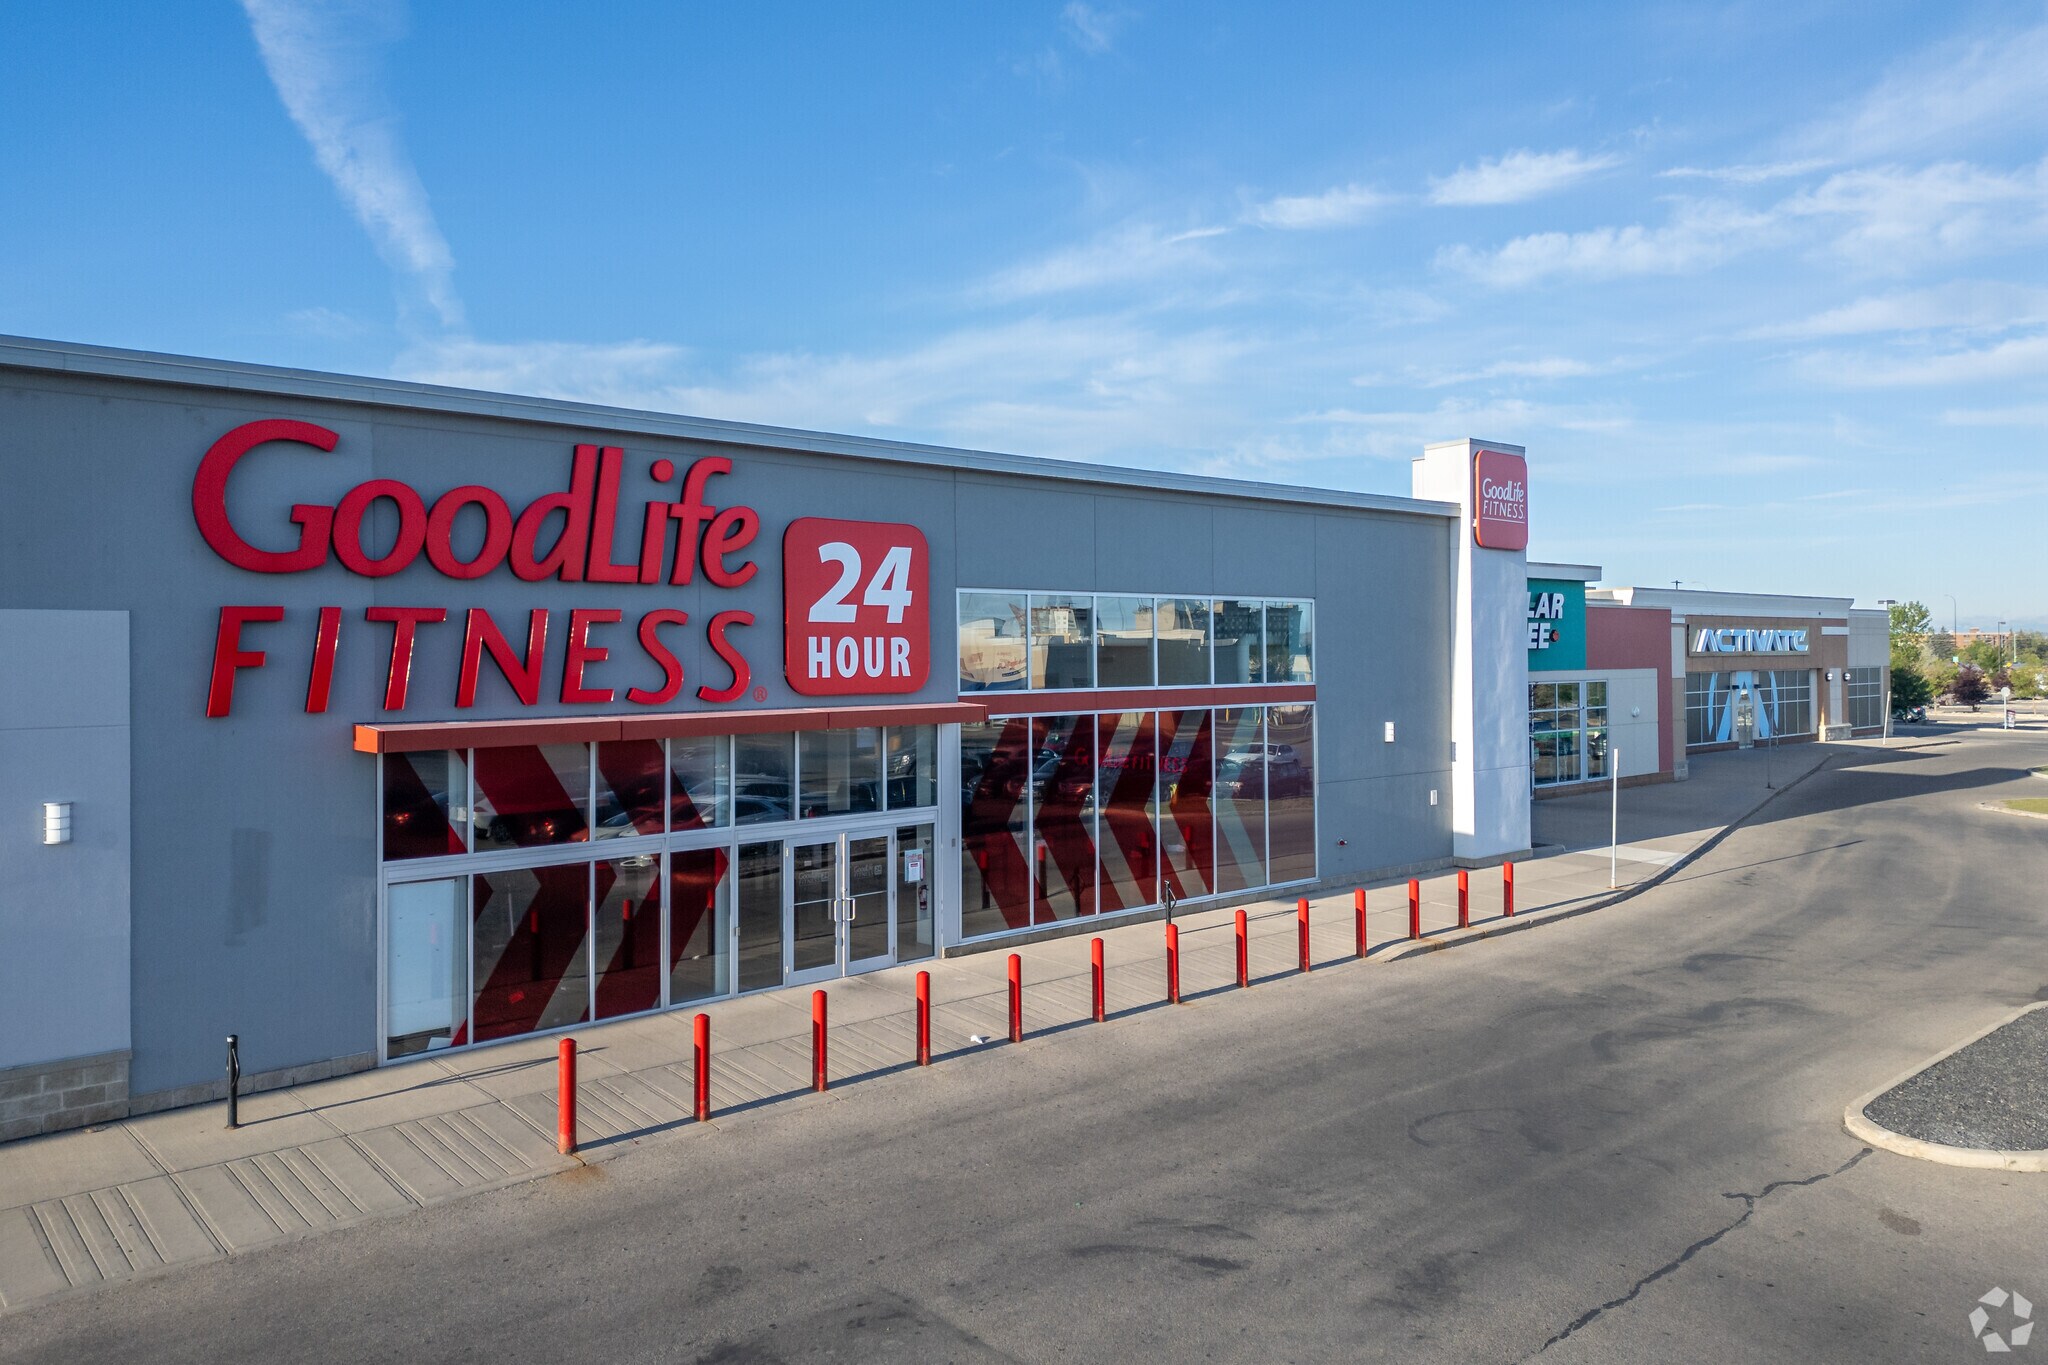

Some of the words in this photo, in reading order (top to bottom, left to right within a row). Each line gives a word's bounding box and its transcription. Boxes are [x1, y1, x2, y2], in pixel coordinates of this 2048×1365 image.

[192, 418, 759, 588] GoodLife
[1482, 477, 1525, 503] GoodLife
[1483, 500, 1525, 519] FITNESS
[808, 541, 913, 624] 24
[206, 605, 756, 718] FITNESS
[808, 636, 911, 678] HOUR
[1693, 628, 1809, 653] ACTIVATE
